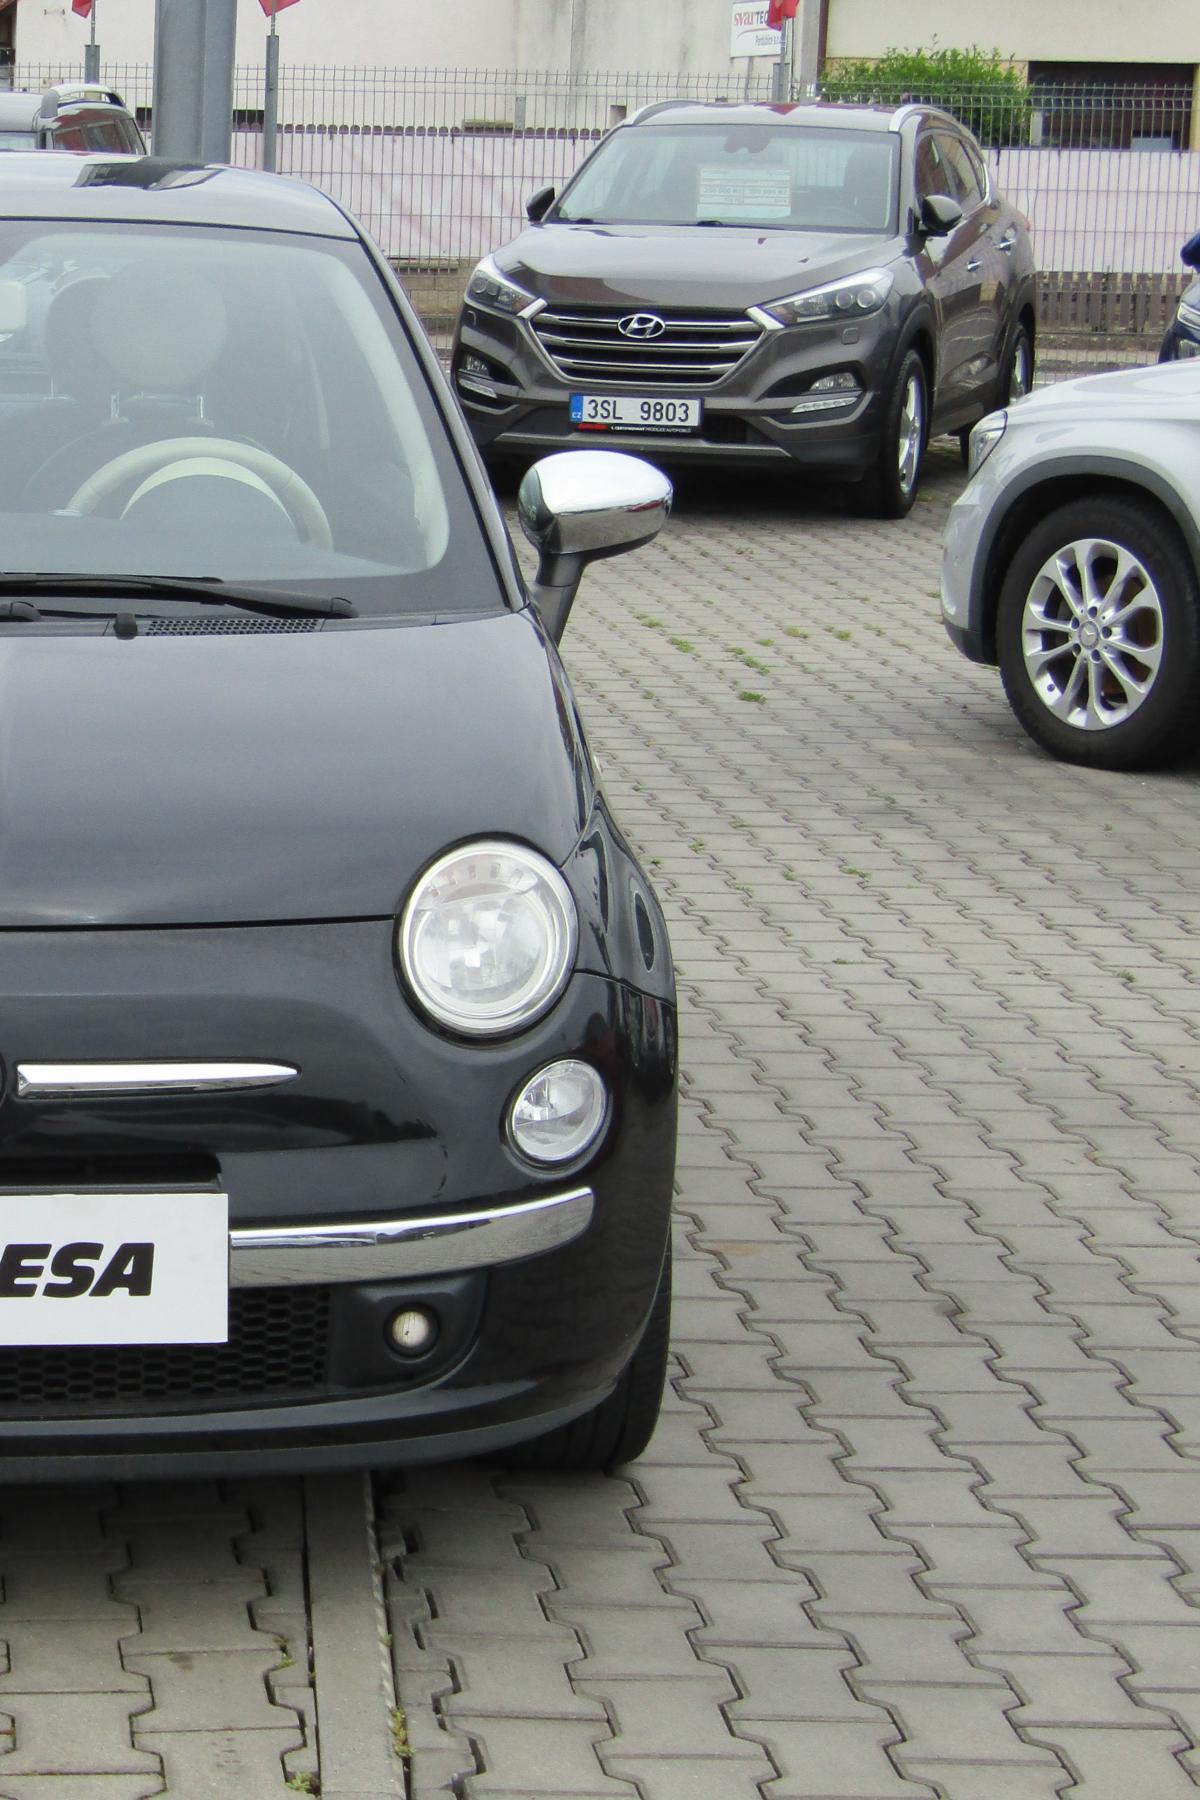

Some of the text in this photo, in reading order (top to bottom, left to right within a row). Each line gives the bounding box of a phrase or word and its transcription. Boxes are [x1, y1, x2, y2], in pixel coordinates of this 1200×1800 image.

[735, 11, 769, 26] svarTEC
[572, 411, 582, 419] CZ
[588, 399, 689, 422] 3SL 9803
